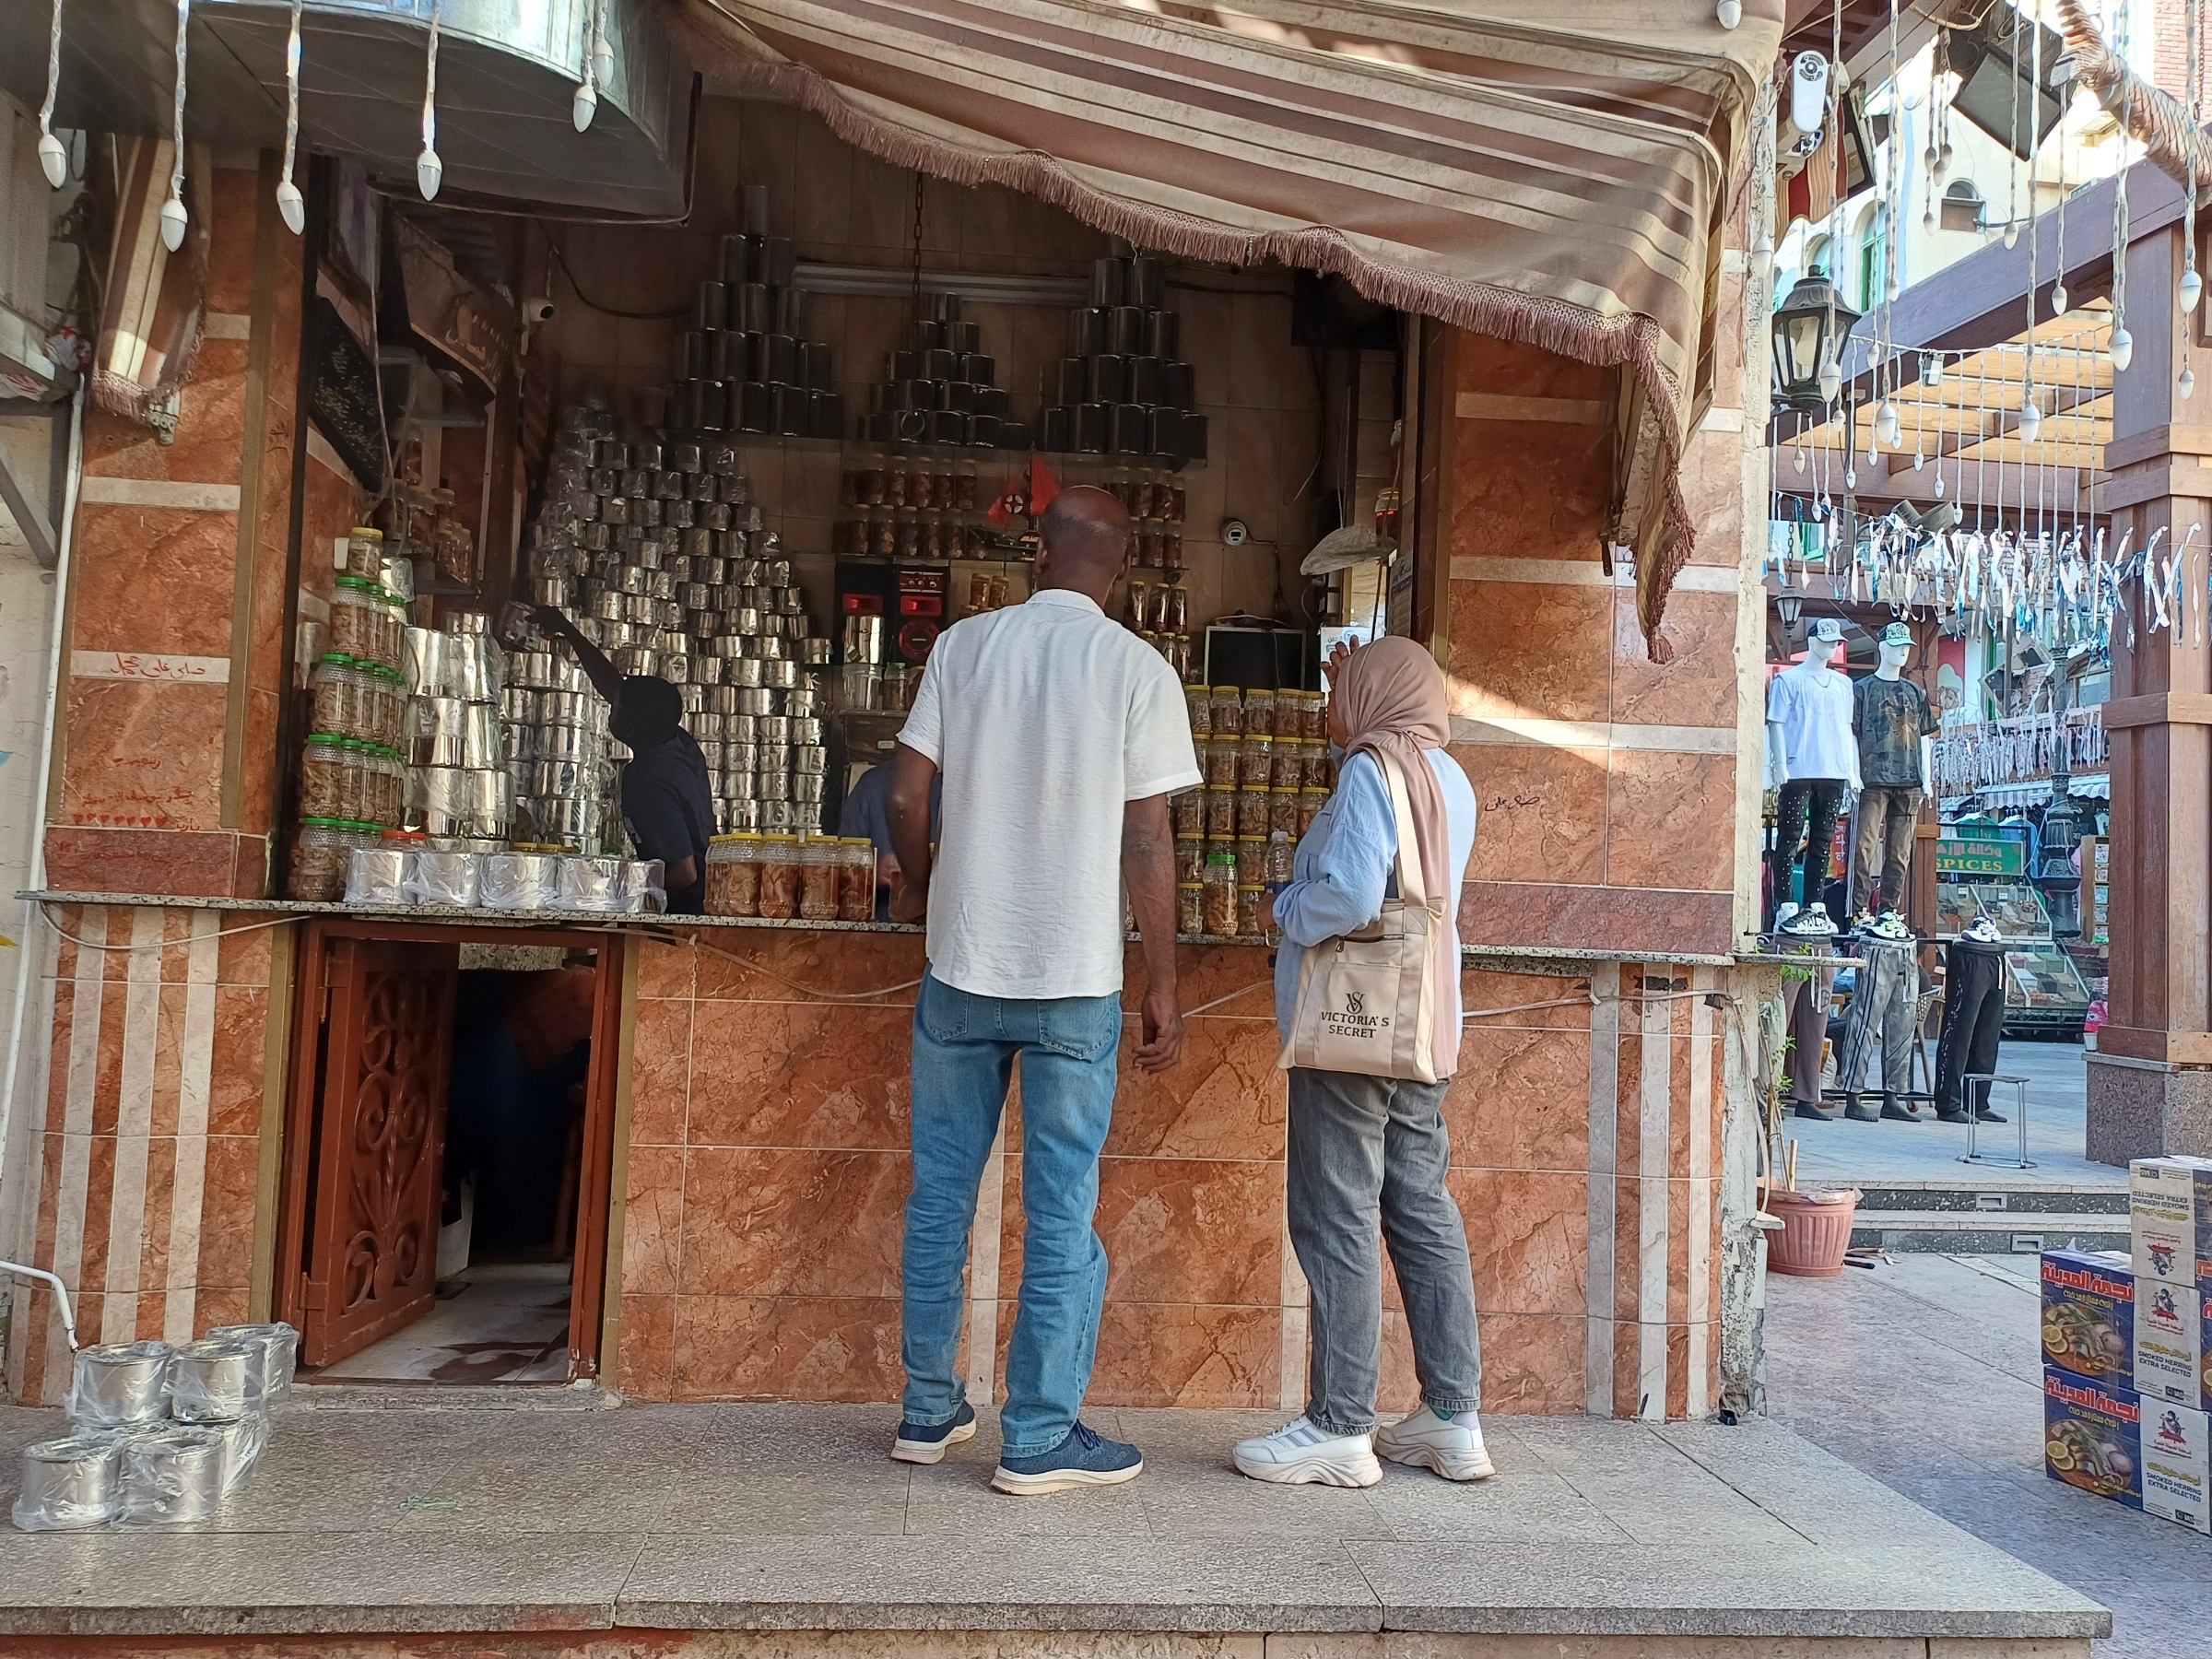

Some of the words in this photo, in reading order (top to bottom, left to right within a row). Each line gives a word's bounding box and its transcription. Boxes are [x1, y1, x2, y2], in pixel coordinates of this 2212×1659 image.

[1936, 858, 2003, 872] SPICES
[1329, 1024, 1376, 1039] SECRET
[2132, 1190, 2165, 1201] SELECTED
[2132, 1197, 2160, 1206] HERRING
[2165, 1194, 2188, 1204] EXTRA
[2161, 1201, 2190, 1211] SMOKED
[2041, 1261, 2091, 1291] المدينة
[2091, 1273, 2134, 1303] نجمة
[2137, 1350, 2164, 1363] SMOKED
[2164, 1358, 2193, 1371] HERRING
[2138, 1358, 2159, 1369] EXTRA
[2160, 1364, 2192, 1378] SELECTED
[2045, 1375, 2096, 1410] المدينة
[2096, 1391, 2140, 1423] نجمة
[2146, 1472, 2173, 1486] SMOKED
[2173, 1481, 2203, 1496] HERRING
[2147, 1479, 2169, 1492] EXTRA
[2170, 1487, 2202, 1502] SELECTED
